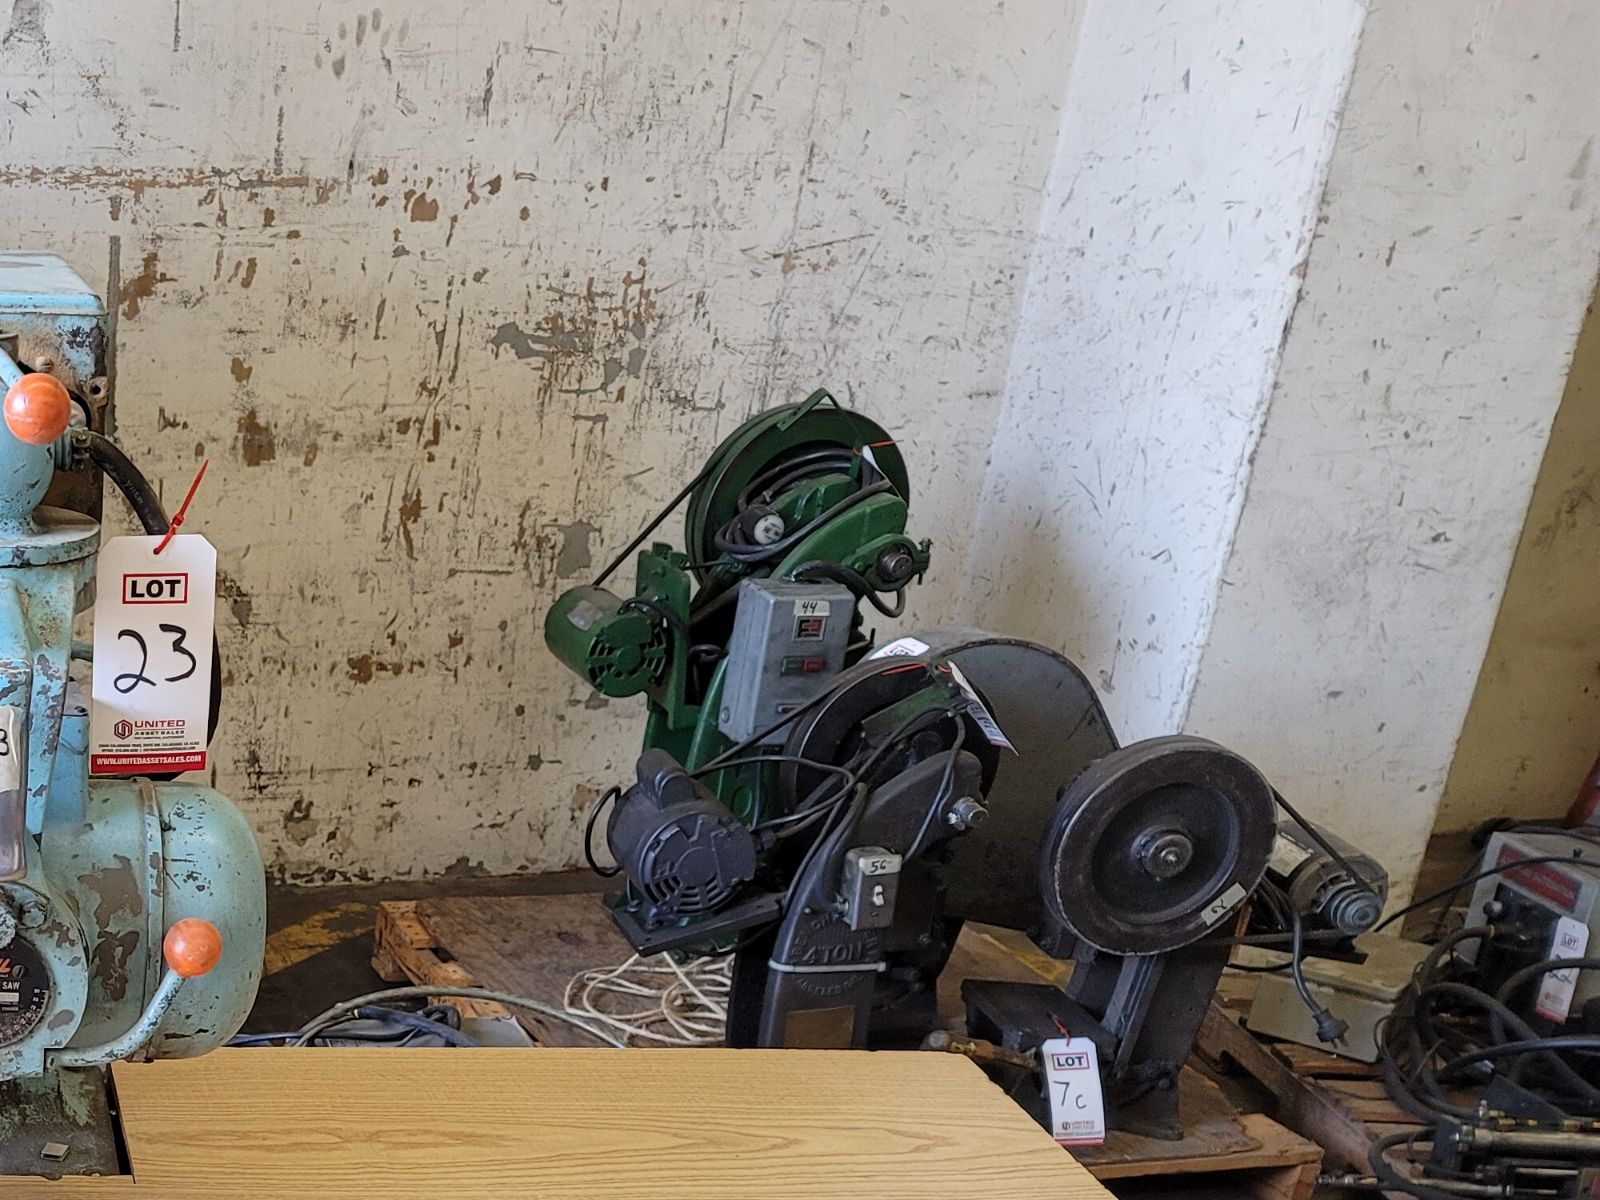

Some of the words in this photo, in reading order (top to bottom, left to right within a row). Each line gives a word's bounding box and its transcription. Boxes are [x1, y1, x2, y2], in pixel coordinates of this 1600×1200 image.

[130, 579, 181, 598] LOT
[802, 601, 818, 614] 44
[114, 623, 197, 694] 23
[134, 720, 186, 728] UNITED
[96, 754, 202, 765] WWW.UNITEDASSETSALES.COM
[2, 982, 20, 990] SAW
[1056, 1056, 1084, 1067] LOT
